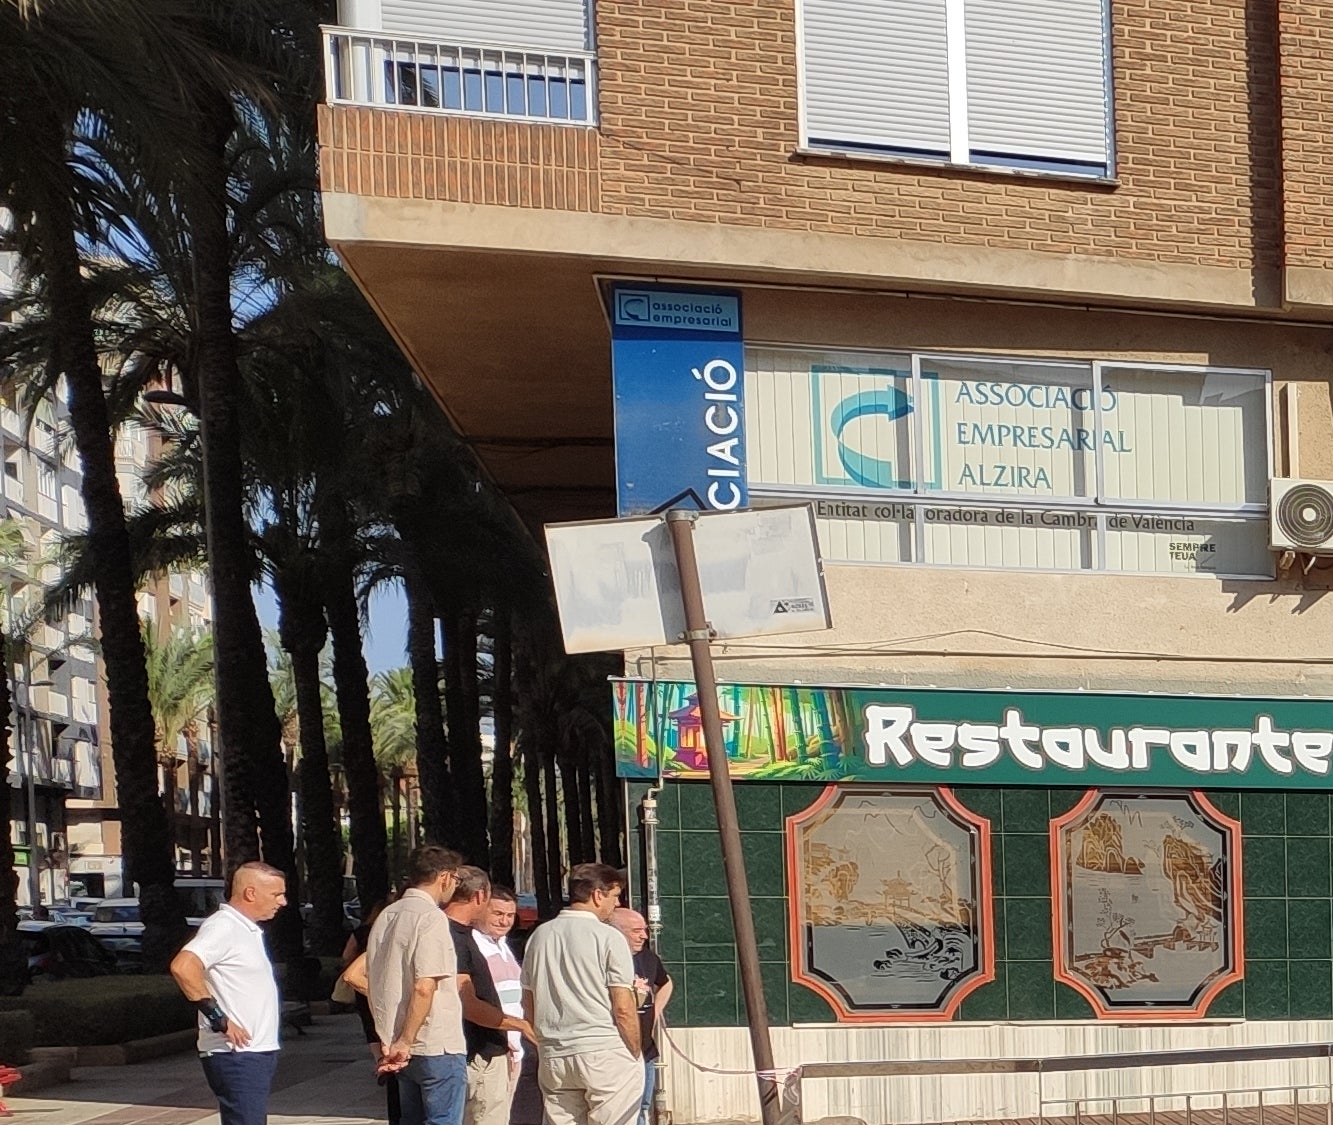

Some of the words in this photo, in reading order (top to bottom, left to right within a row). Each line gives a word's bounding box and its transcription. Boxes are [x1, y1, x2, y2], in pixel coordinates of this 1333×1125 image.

[652, 302, 723, 315] associació
[652, 314, 732, 327] empresarial
[955, 382, 1117, 412] ASSOCIACIÓ
[958, 463, 1053, 490] ALZIRA
[817, 500, 868, 517] Entitat
[874, 503, 989, 523] col·laoradora
[995, 508, 1015, 525] de
[1021, 508, 1034, 526] la
[1040, 510, 1099, 528] Cambr
[1108, 512, 1128, 529] de
[1169, 543, 1216, 552] SEMPRE
